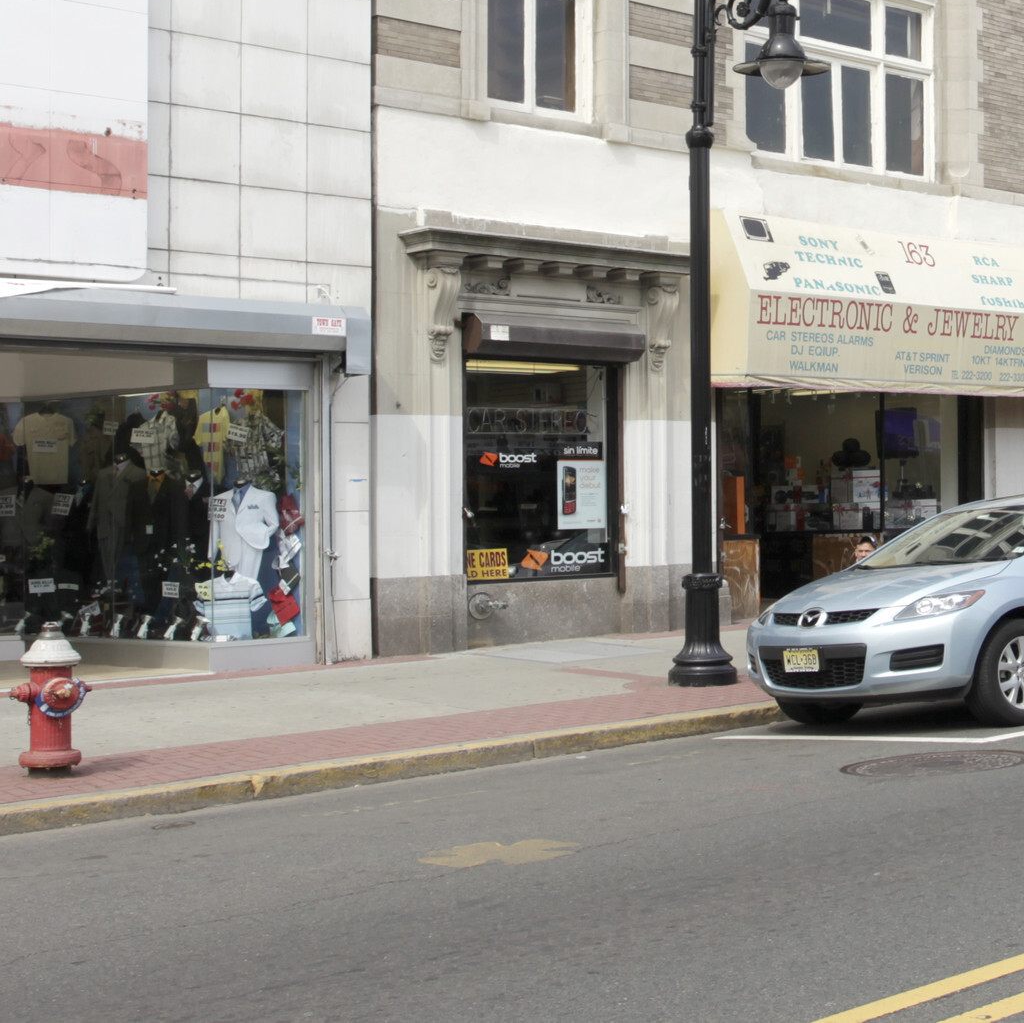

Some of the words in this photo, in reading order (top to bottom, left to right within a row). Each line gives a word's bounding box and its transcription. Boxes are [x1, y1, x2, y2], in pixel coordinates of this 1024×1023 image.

[798, 235, 838, 251] SONY
[794, 250, 863, 269] TECHNIC
[897, 240, 936, 267] 163
[972, 256, 1000, 268] RCA
[971, 274, 1013, 287] SHARP
[757, 294, 894, 332] ELECTRONIC
[903, 306, 918, 334] &
[927, 308, 1019, 342] JEWELRY
[766, 330, 786, 341] CAR
[791, 331, 834, 344] STEREOS
[837, 334, 874, 347] ALARMS
[791, 345, 804, 356] DJ
[895, 351, 918, 361] AT&T
[919, 352, 950, 363] SPRINT
[789, 360, 839, 373] WALKMAN
[904, 364, 943, 375] VERISON
[563, 446, 575, 454] sin
[576, 445, 599, 455] límite
[499, 452, 537, 464] boost
[479, 551, 506, 568] CARDS
[550, 548, 605, 565] boost
[482, 568, 507, 577] HERE
[550, 565, 581, 573] mobile
